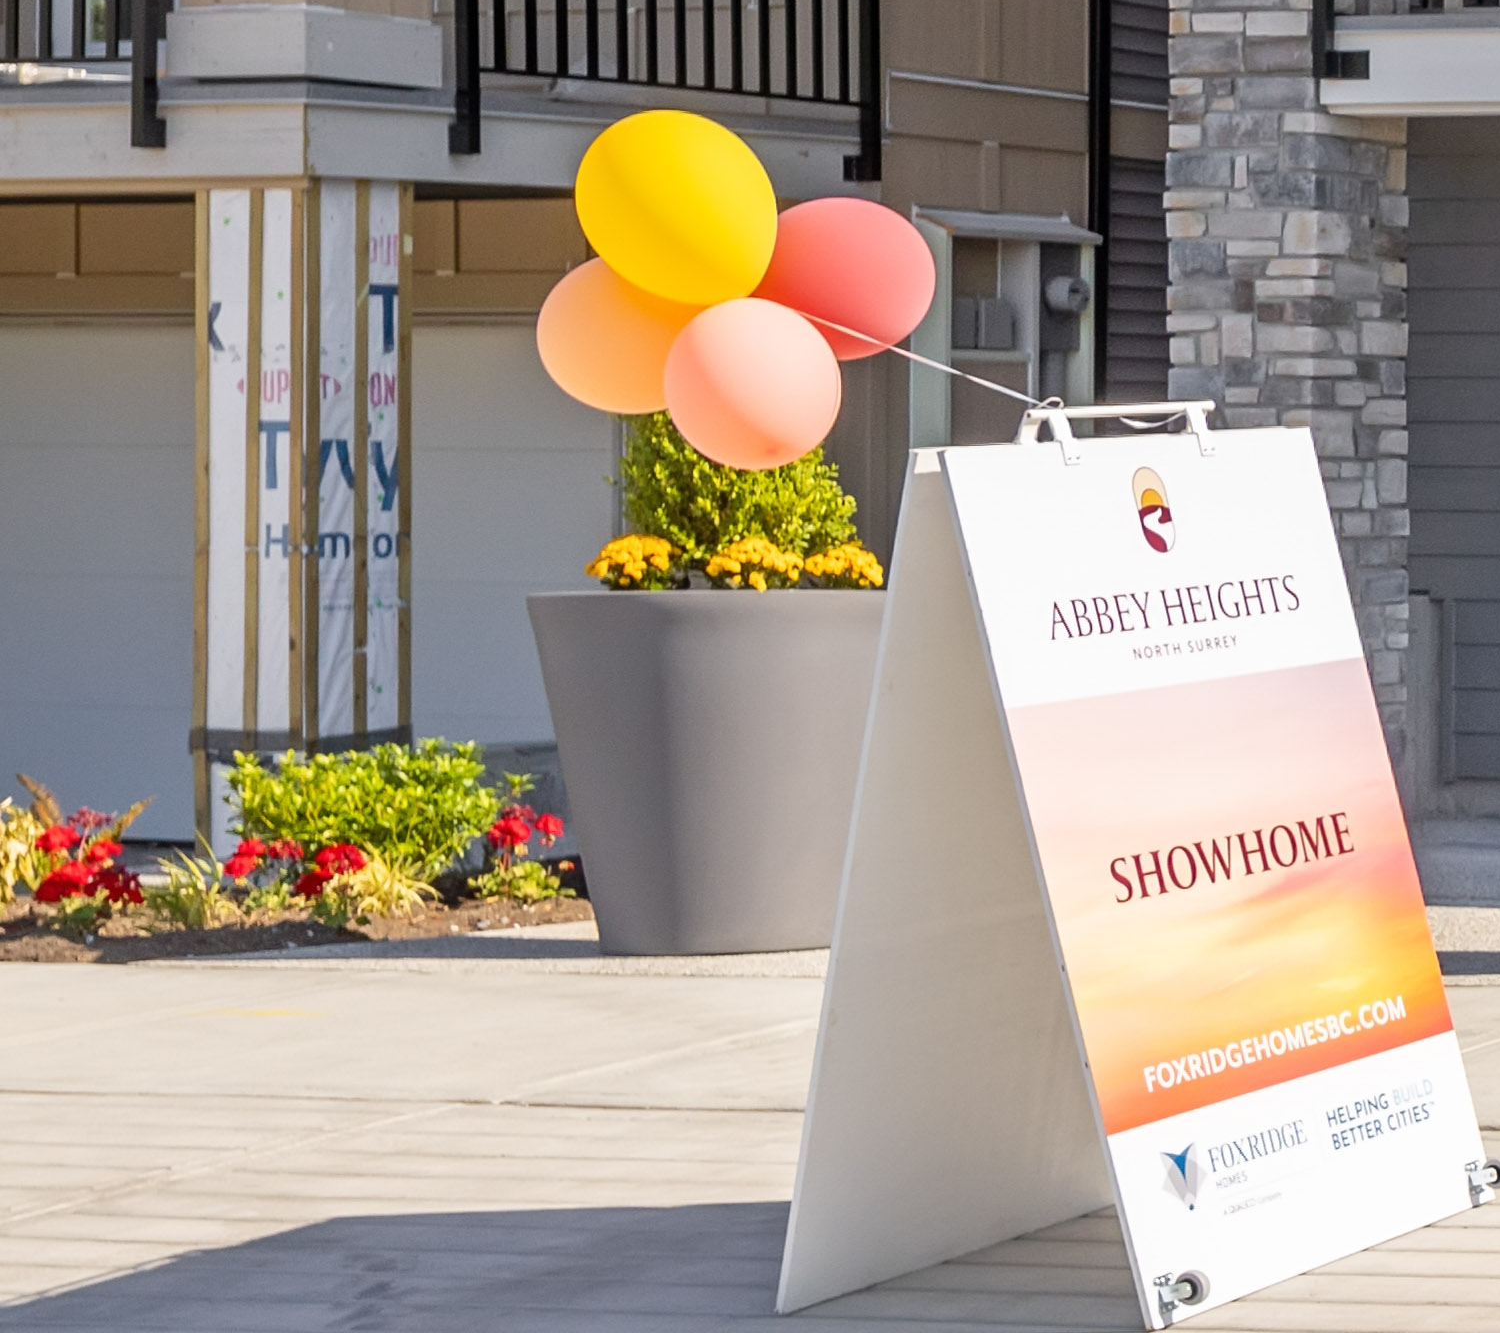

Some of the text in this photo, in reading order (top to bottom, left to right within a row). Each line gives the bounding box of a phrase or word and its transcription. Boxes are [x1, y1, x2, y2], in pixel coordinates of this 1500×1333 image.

[1050, 574, 1300, 641] ABBEY HEIGHTS
[1132, 634, 1239, 661] NORTH SURREY
[1109, 811, 1355, 903] SHOWHOME
[1143, 994, 1407, 1093] FOXRIDGEHOMESBC.COM
[1325, 1078, 1433, 1128] HELPING BUILD
[1207, 1119, 1309, 1173] FOXRIDGE
[1331, 1119, 1385, 1151] BETTER
[1215, 1170, 1249, 1189] HOMES
